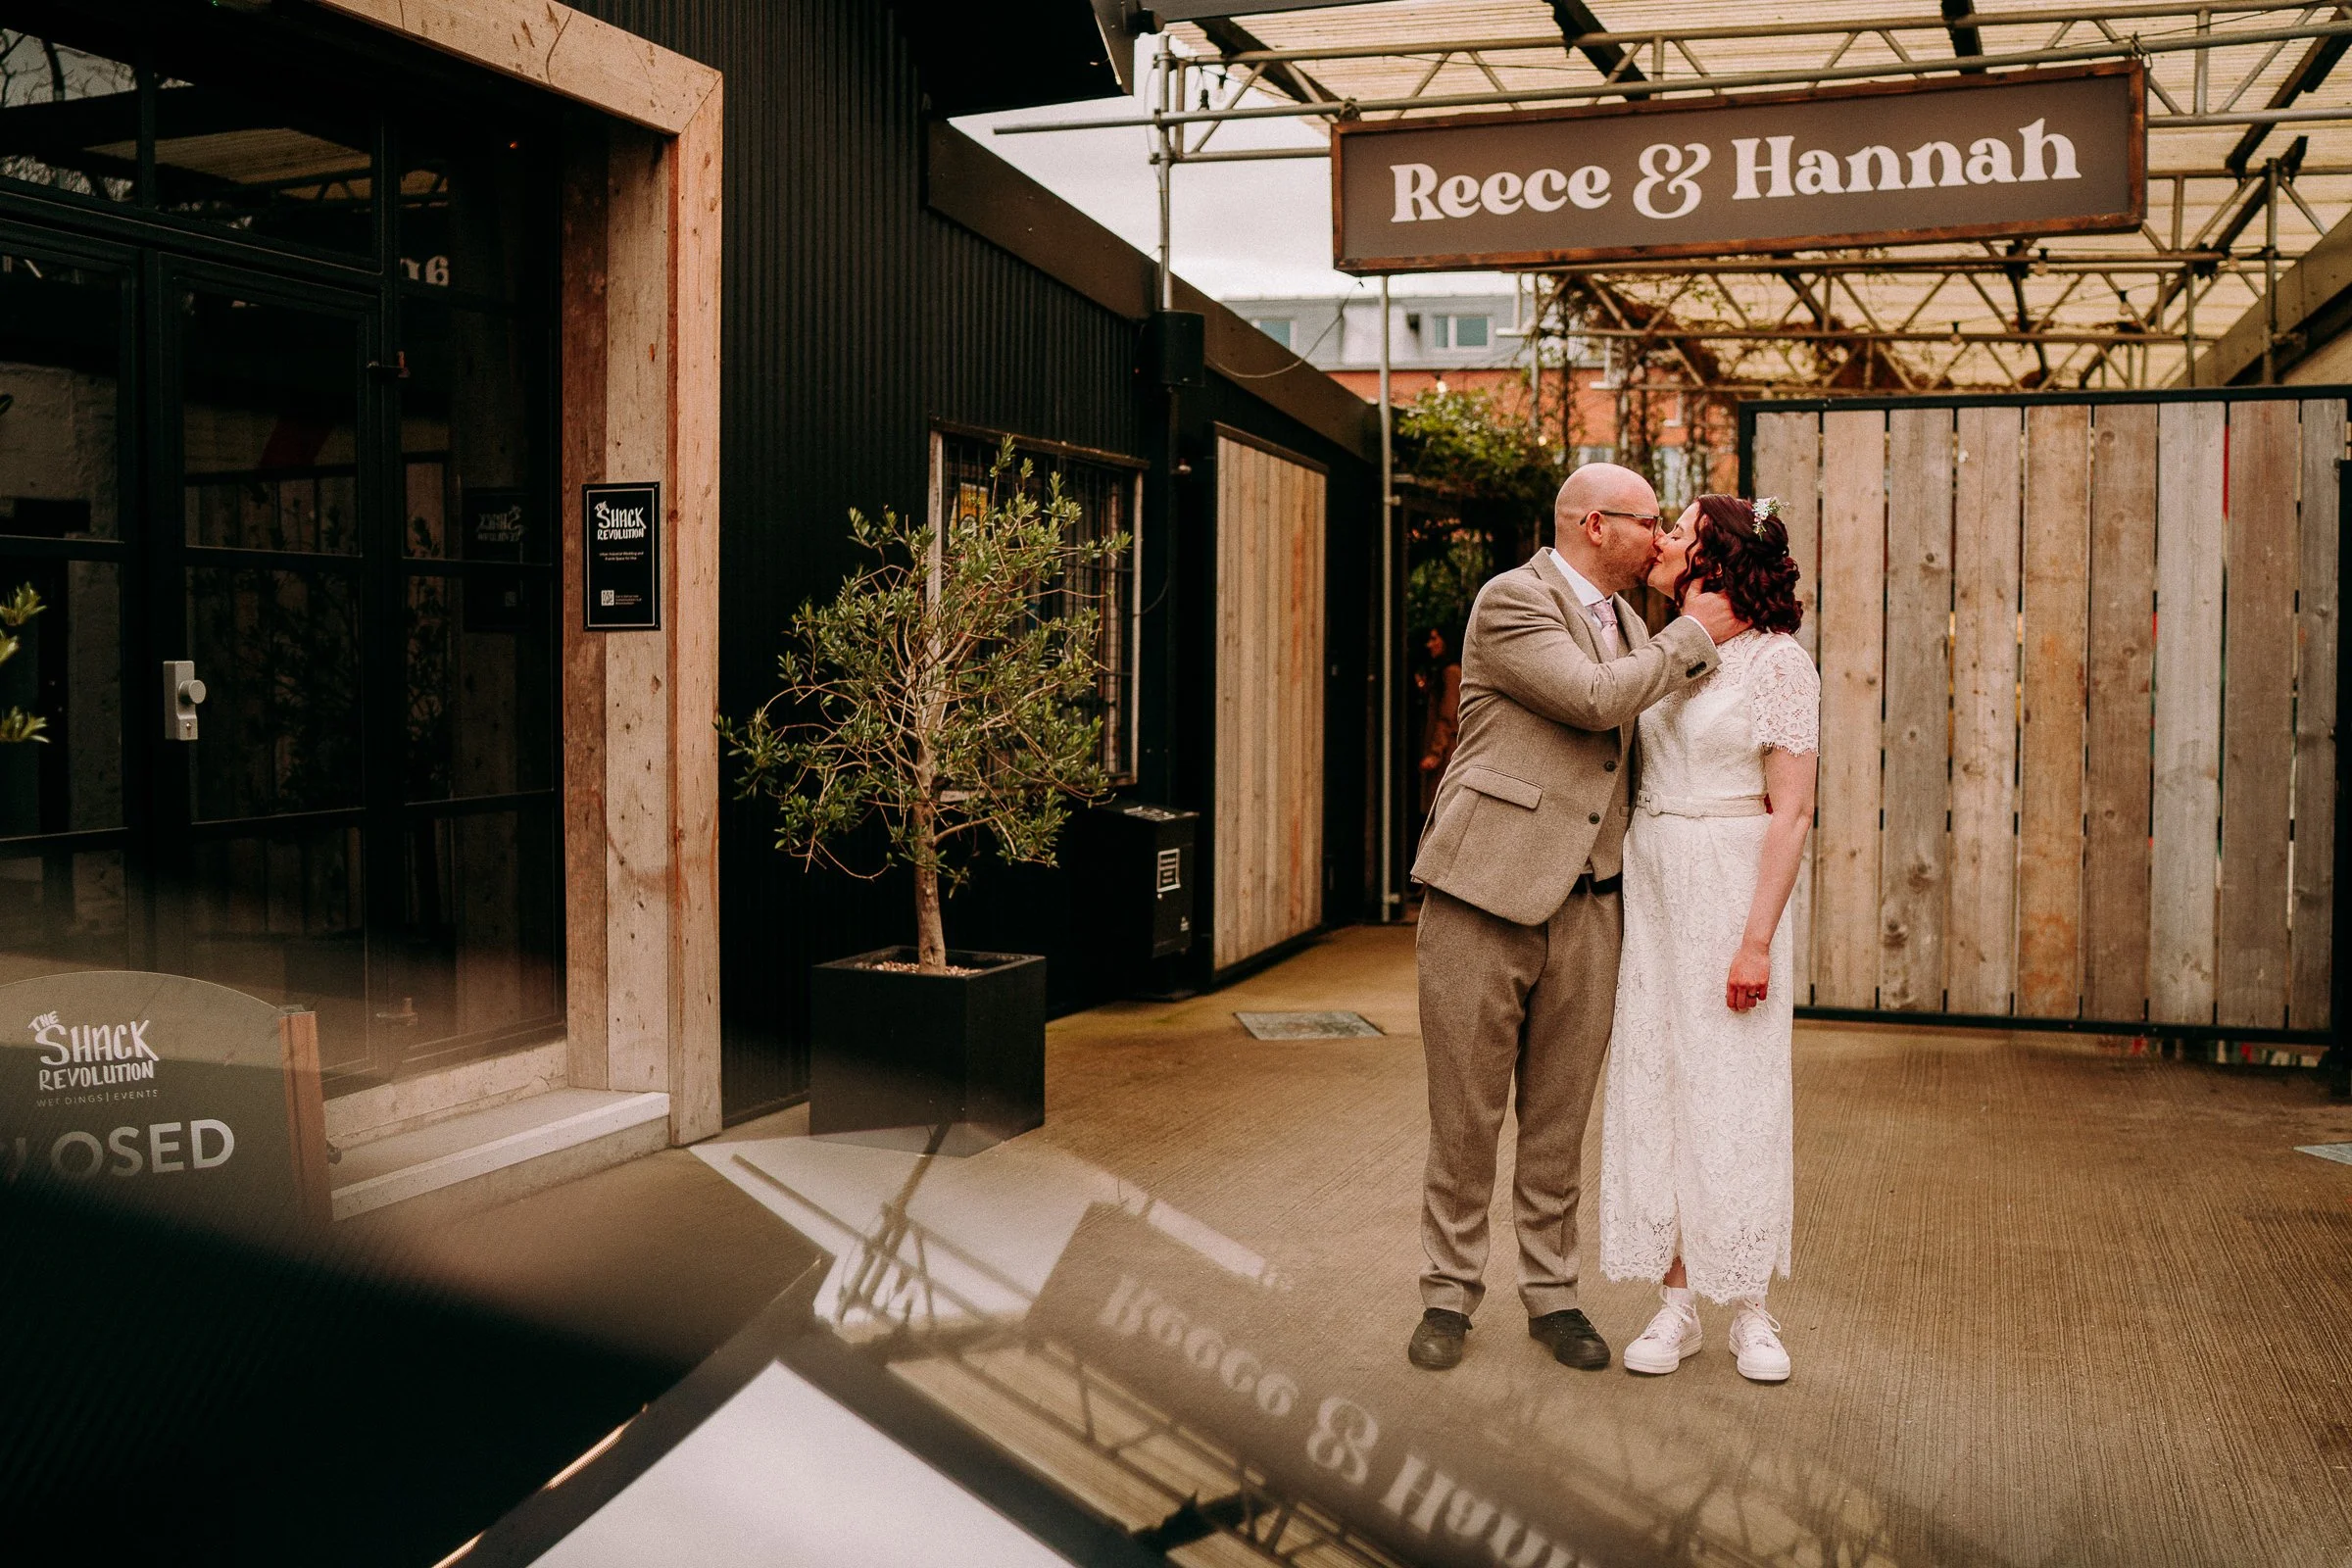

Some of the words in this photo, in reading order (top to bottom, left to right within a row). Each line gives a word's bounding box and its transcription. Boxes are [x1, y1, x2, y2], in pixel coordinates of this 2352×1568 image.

[1390, 163, 1612, 222] Reece
[1633, 143, 1712, 220] &
[1731, 118, 2082, 200] Hannah
[597, 507, 647, 529] SHACK
[597, 528, 645, 540] REVOLUTION
[27, 1010, 60, 1032] THE
[35, 1019, 160, 1066] SHACK
[38, 1059, 154, 1092] REVOLUTION
[114, 1089, 159, 1101] EVENTS
[0, 1118, 235, 1178] OSED
